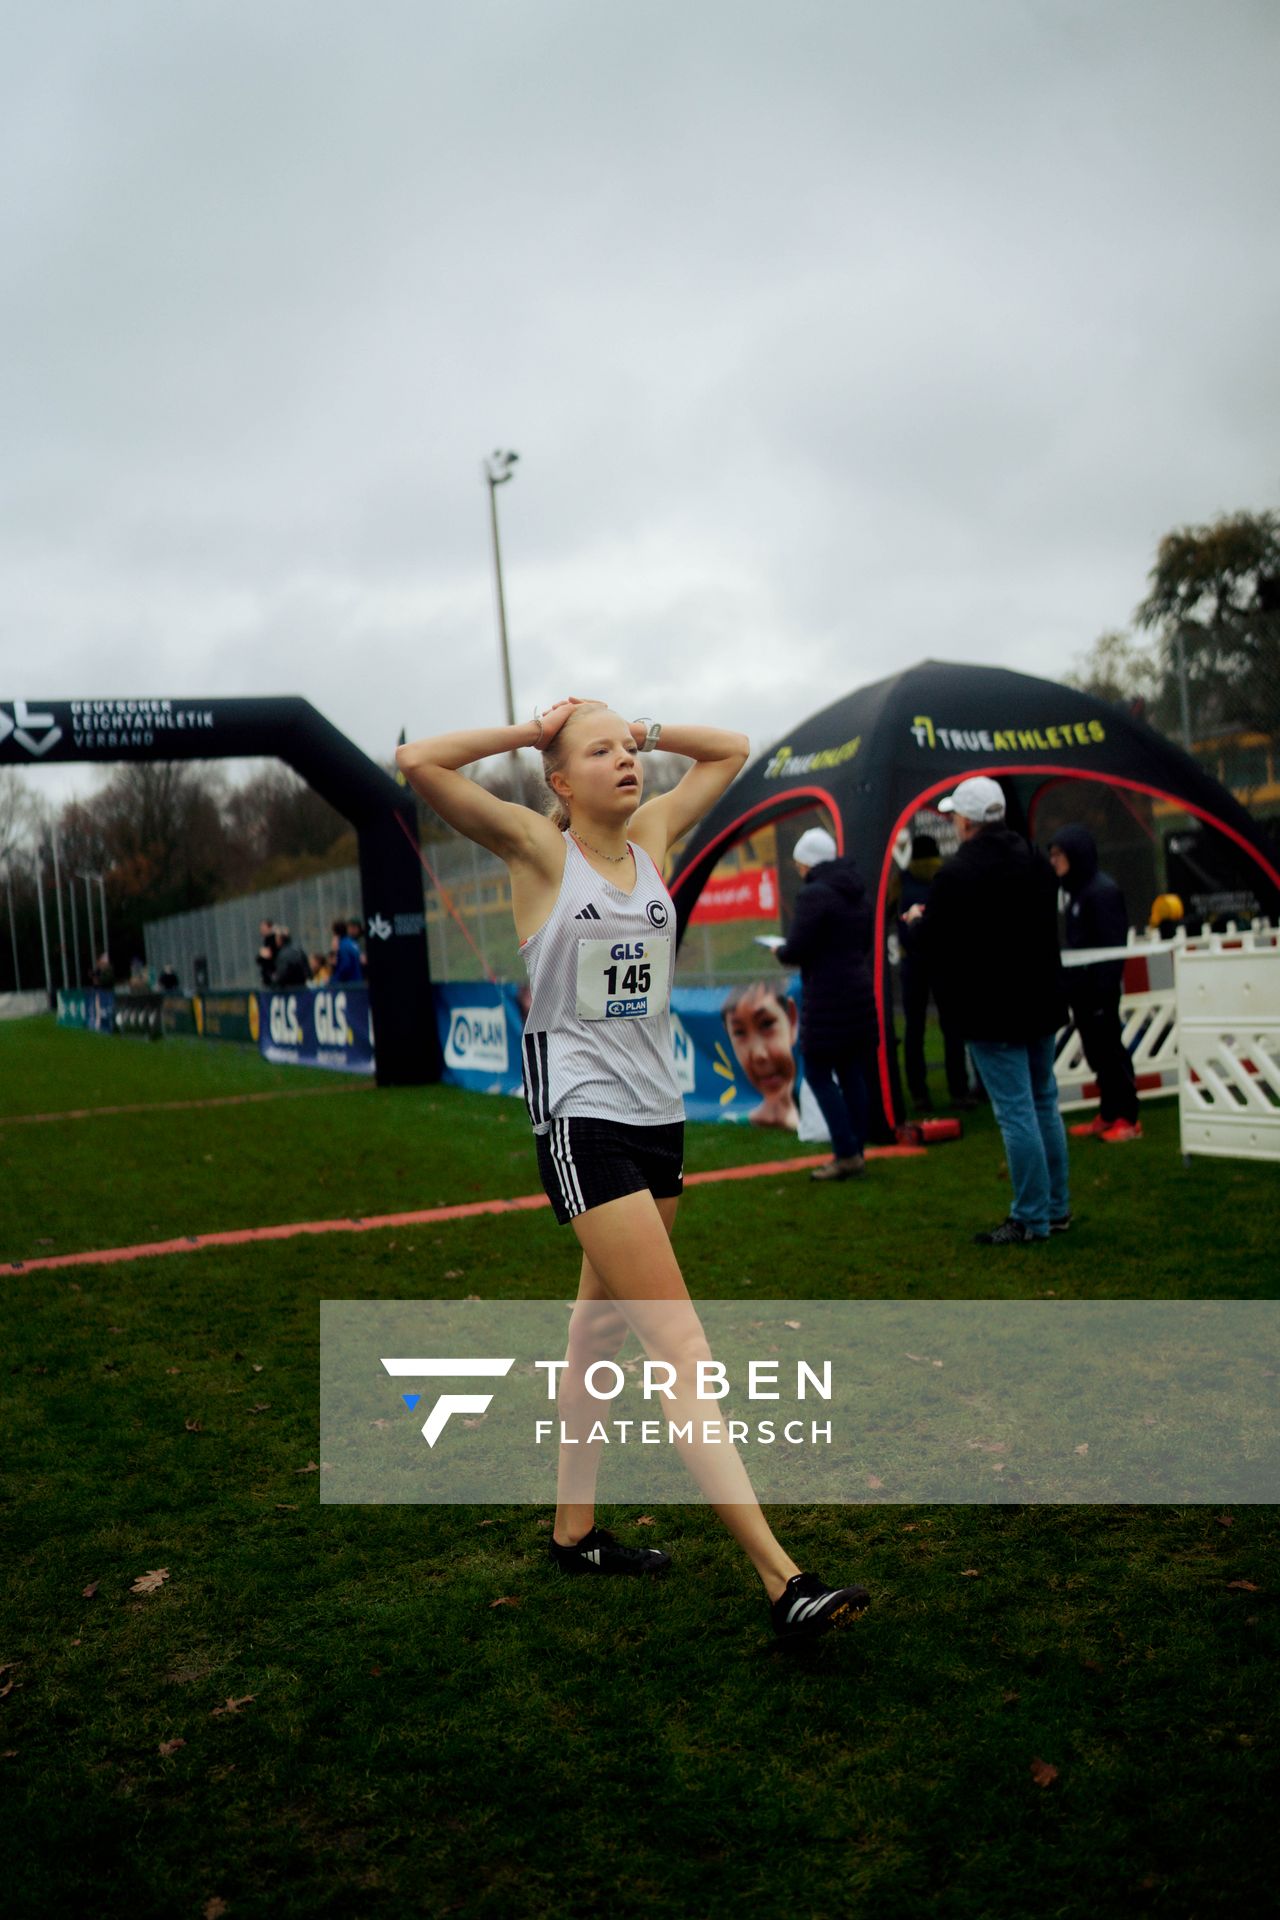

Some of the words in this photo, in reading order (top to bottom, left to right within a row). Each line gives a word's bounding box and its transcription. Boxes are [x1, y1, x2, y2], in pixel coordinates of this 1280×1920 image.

[71, 700, 173, 714] DEUTSCHER
[72, 711, 214, 730] LEICHTATHLETIK
[74, 730, 154, 747] VERBAND
[937, 719, 1105, 752] TRUEATHLETES
[603, 963, 651, 995] 145
[625, 1000, 646, 1010] PLAN
